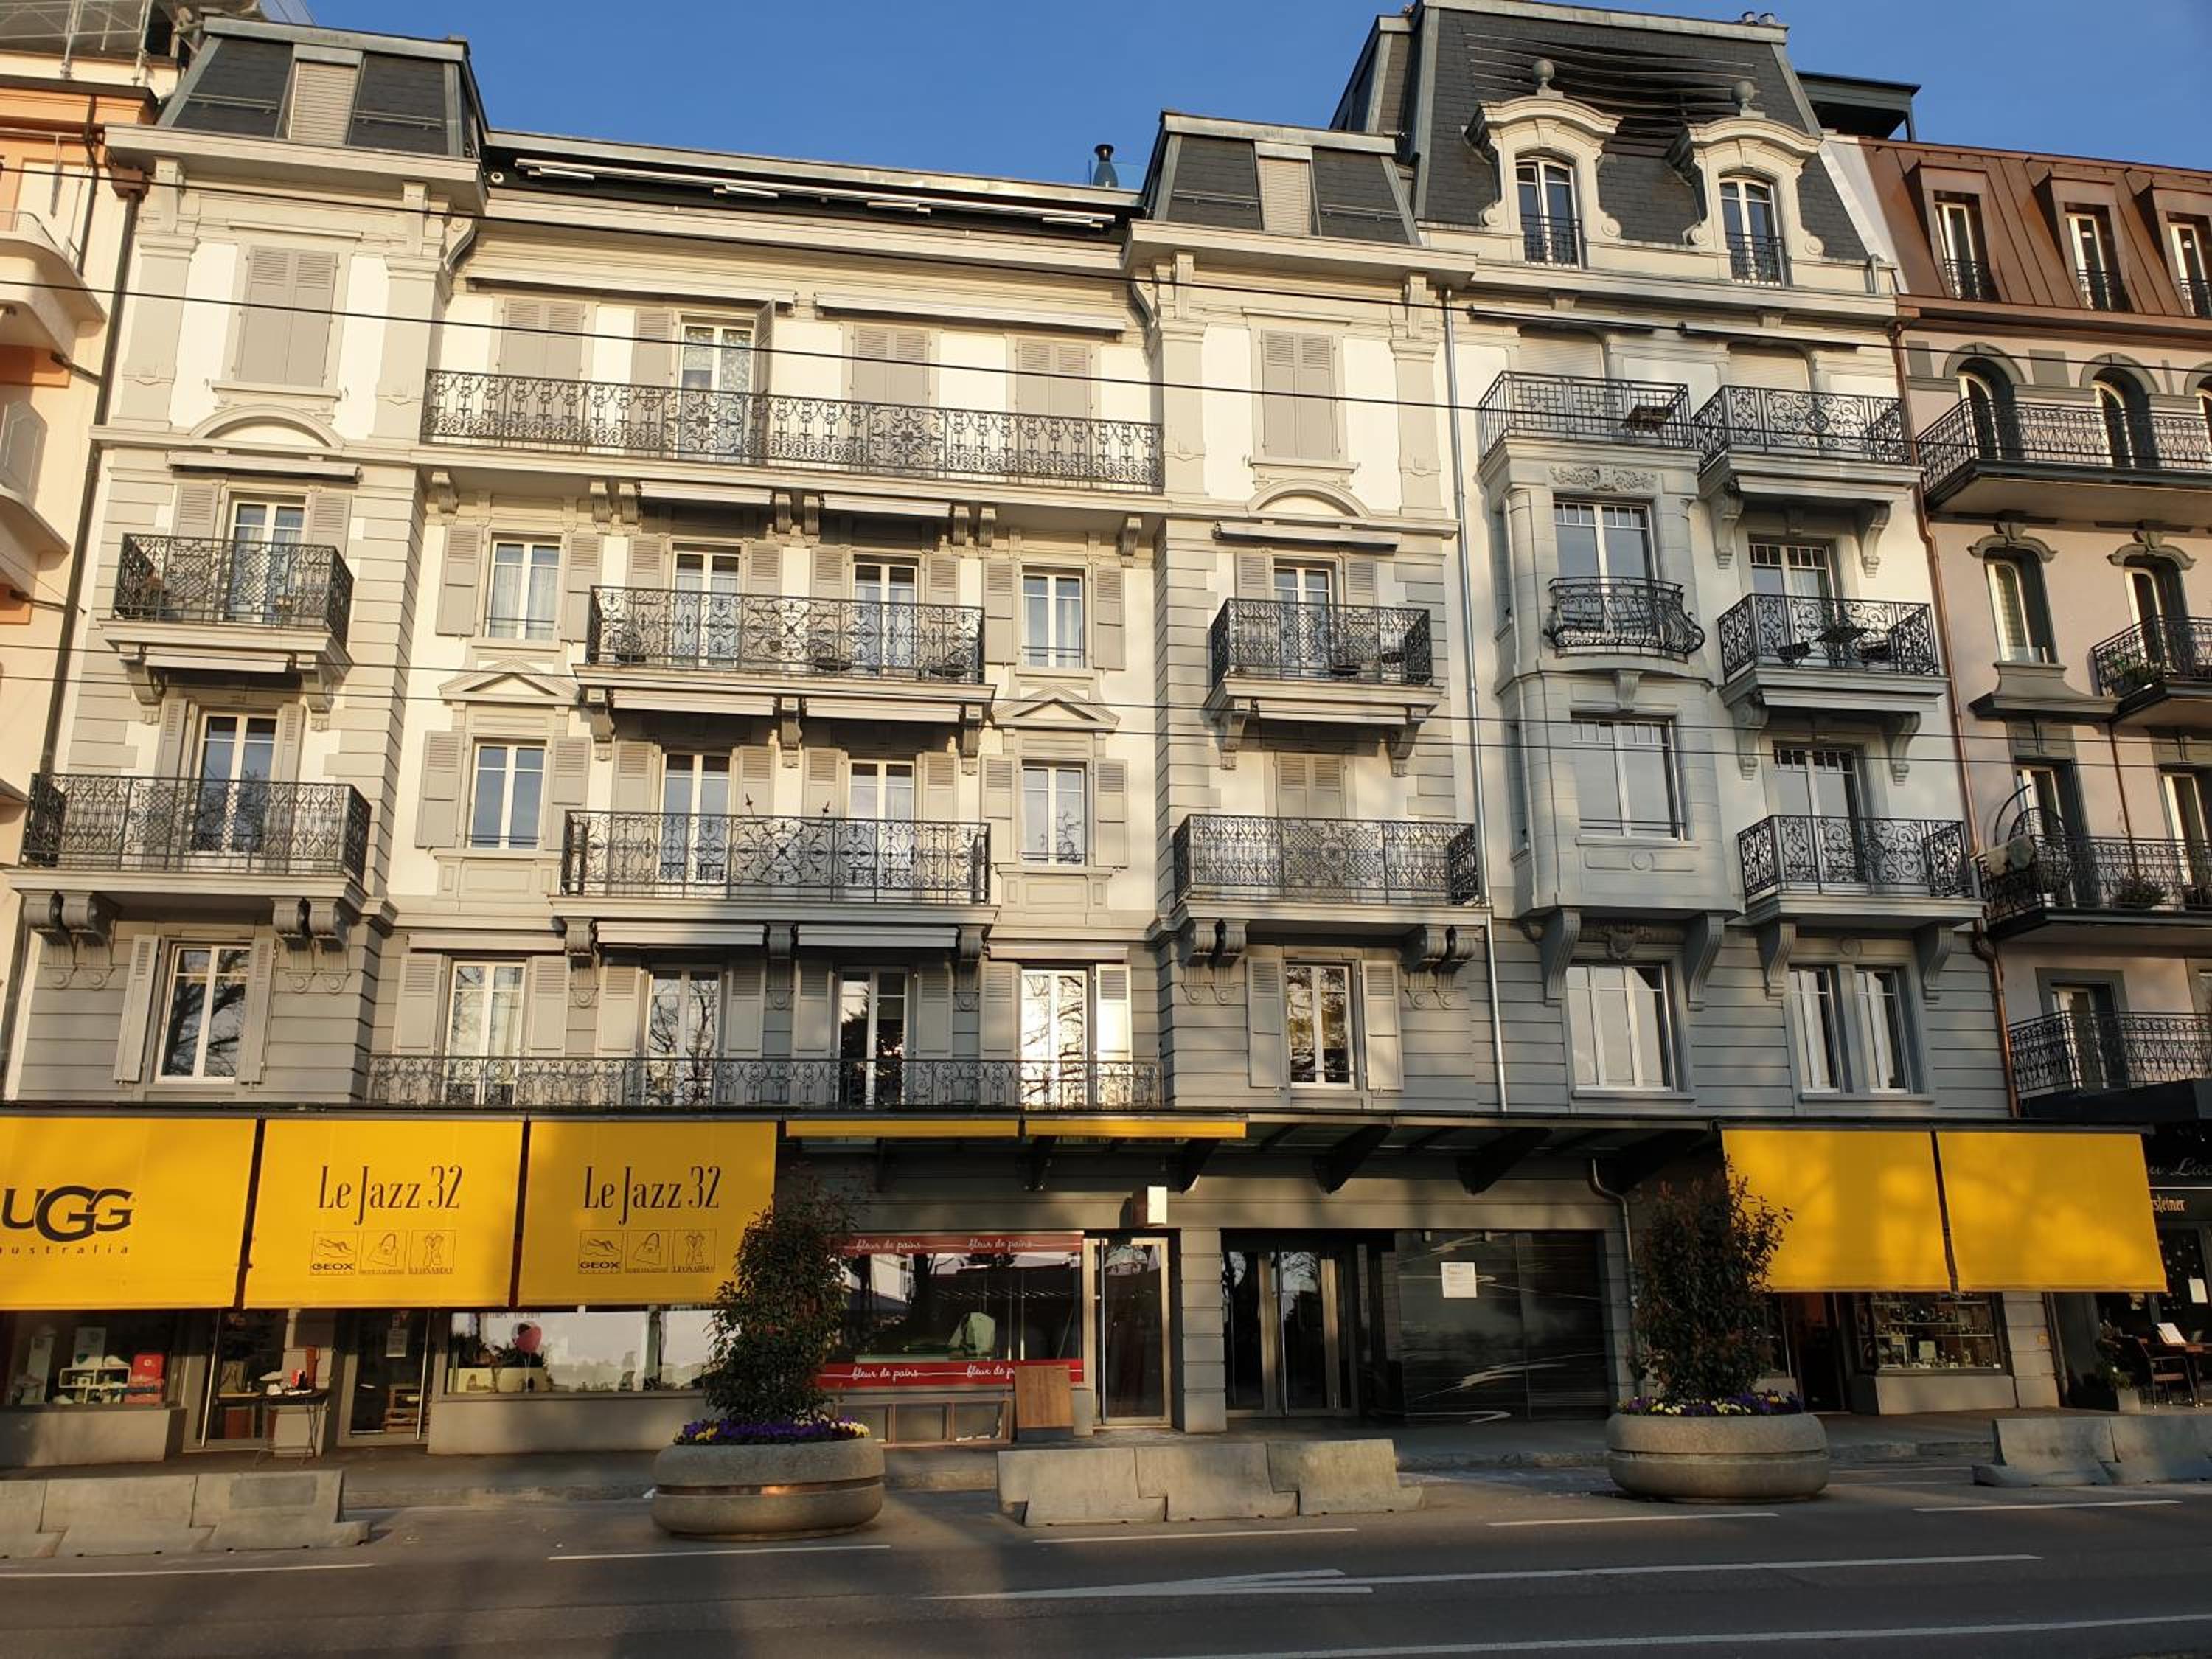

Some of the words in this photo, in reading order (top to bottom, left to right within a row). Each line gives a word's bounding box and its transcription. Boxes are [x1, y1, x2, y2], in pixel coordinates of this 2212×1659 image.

[319, 1166, 352, 1208] Le
[354, 1166, 420, 1225] Jazz
[428, 1165, 462, 1208] 32
[584, 1166, 615, 1208] Le
[618, 1166, 681, 1225] Jazz
[688, 1166, 720, 1208] 32
[1, 1186, 133, 1242] UGG
[855, 1239, 880, 1252] fleur
[883, 1239, 894, 1249] de
[896, 1241, 921, 1253] pains
[968, 1238, 992, 1251] fleur
[995, 1239, 1005, 1248] de
[1006, 1240, 1032, 1253] pains
[851, 1366, 877, 1380] fleur
[880, 1367, 891, 1377] de
[892, 1368, 919, 1382] pains
[967, 1363, 991, 1377] fleur
[993, 1364, 1004, 1375] de
